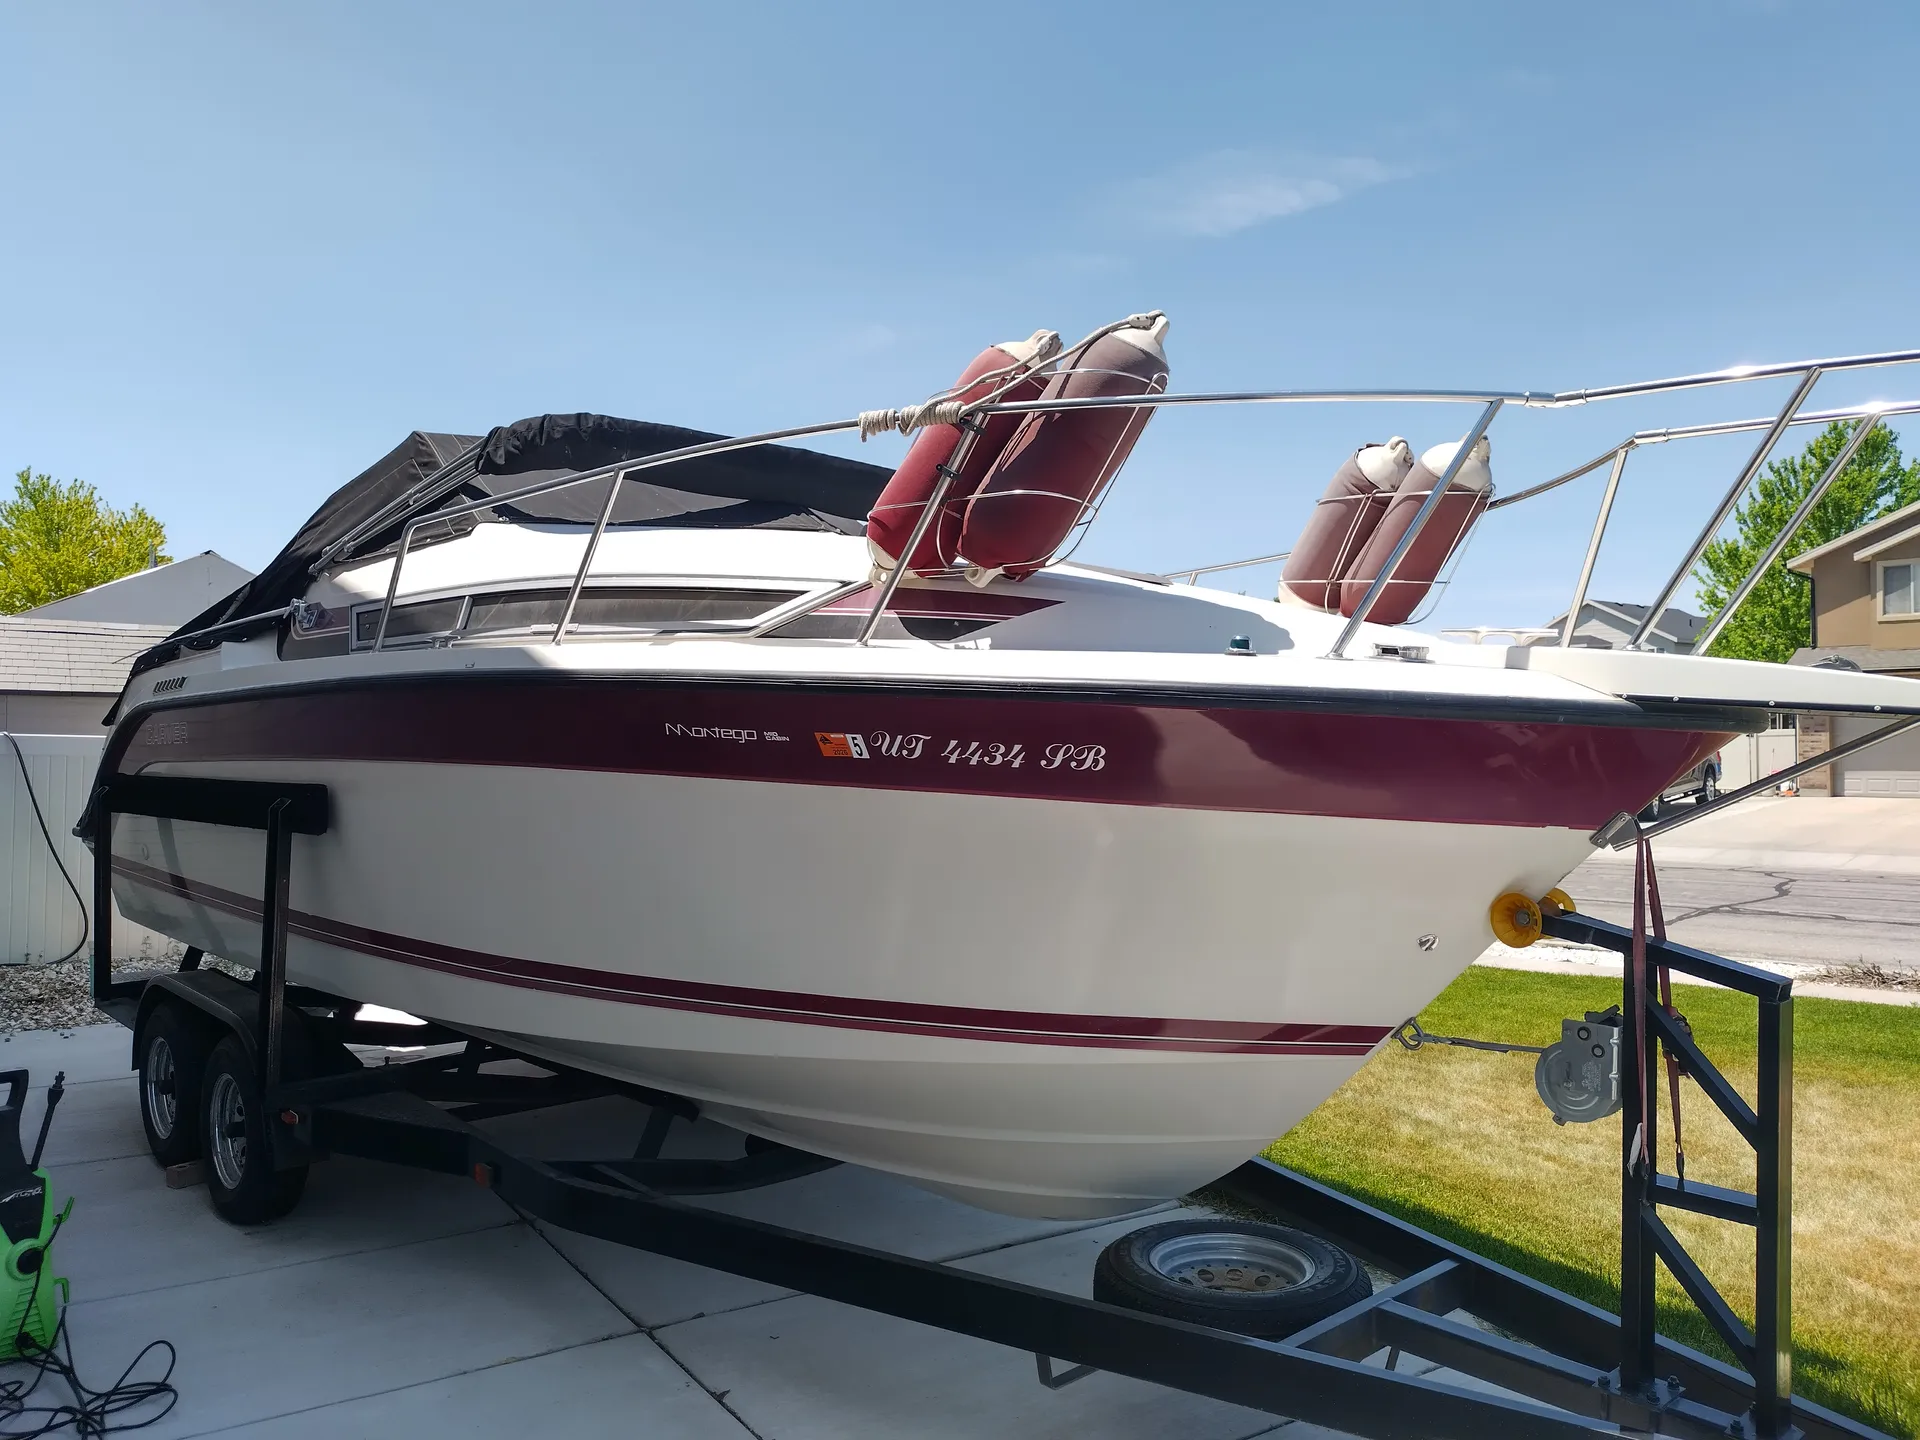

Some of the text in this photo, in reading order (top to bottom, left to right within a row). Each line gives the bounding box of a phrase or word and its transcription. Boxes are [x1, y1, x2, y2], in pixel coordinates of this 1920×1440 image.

[665, 722, 757, 743] Montego
[850, 736, 864, 757] 5
[869, 730, 1107, 771] UT 4434 SB
